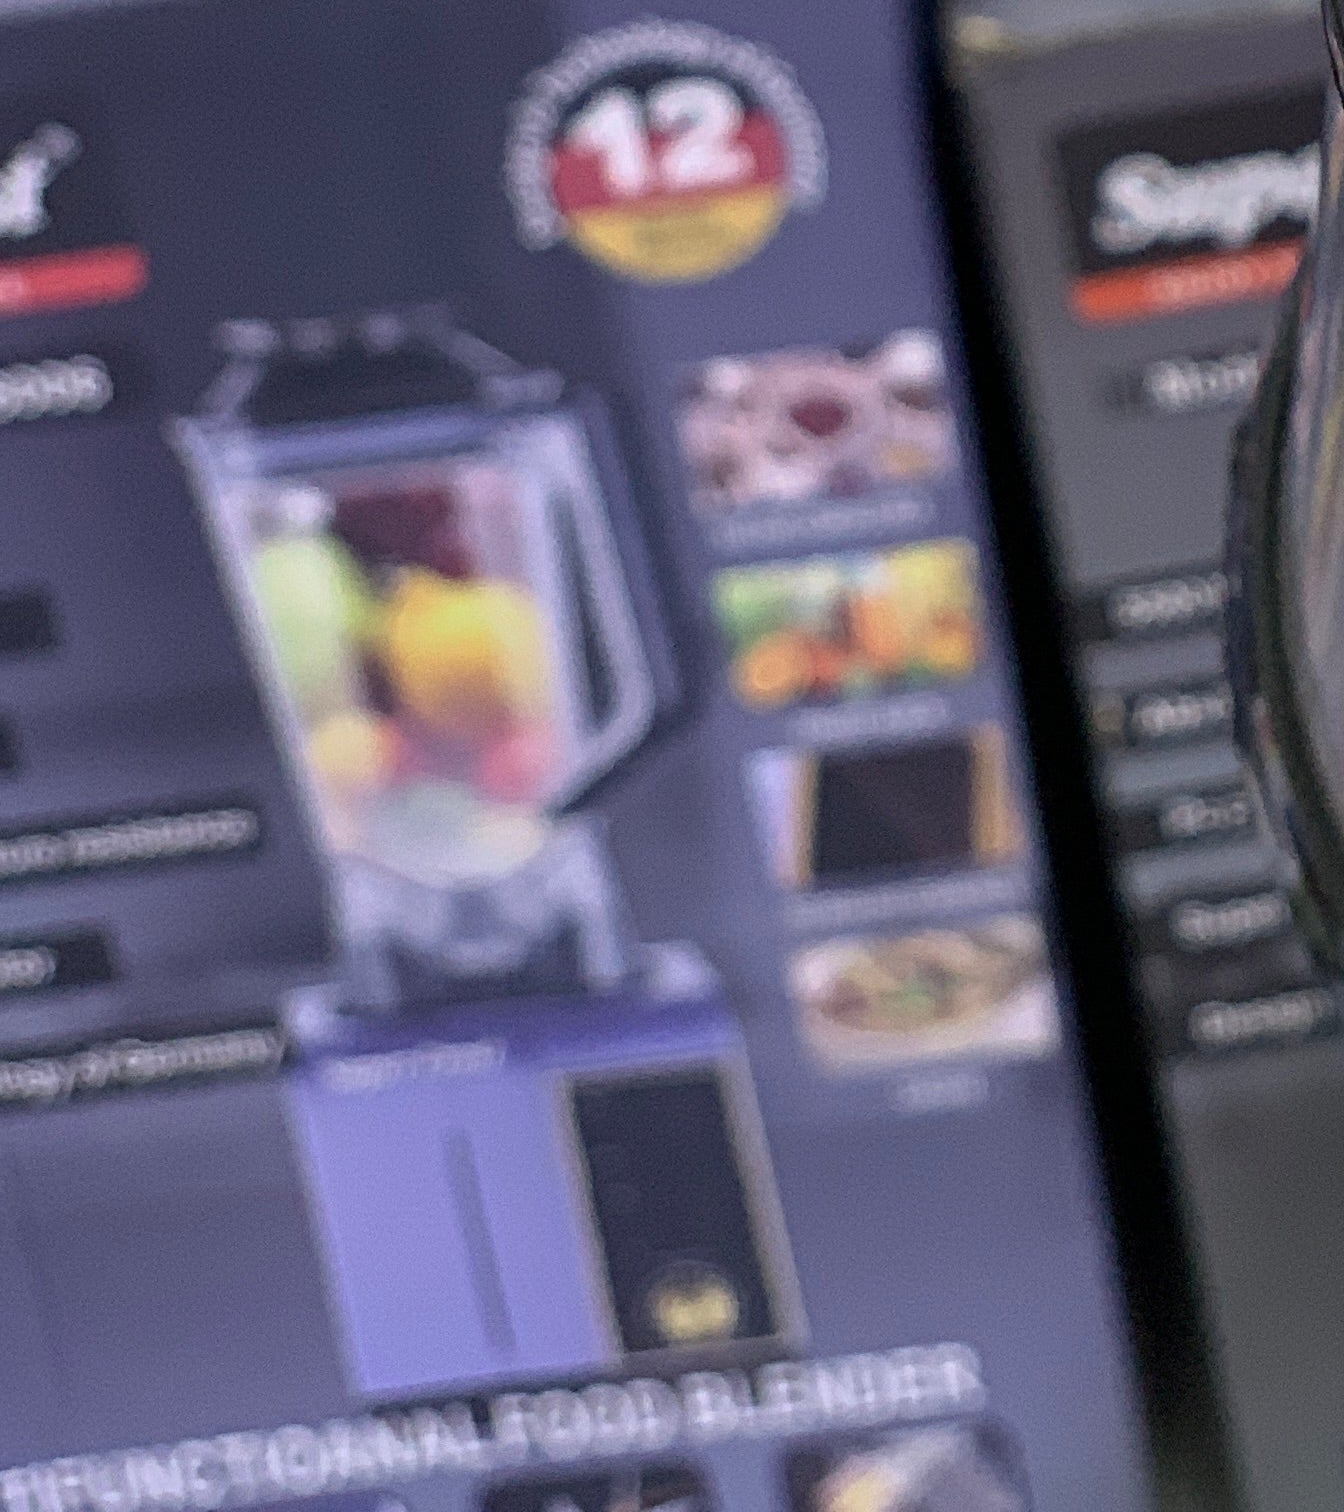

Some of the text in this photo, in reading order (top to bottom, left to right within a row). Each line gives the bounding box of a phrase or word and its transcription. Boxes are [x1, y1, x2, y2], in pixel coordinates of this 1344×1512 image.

[560, 78, 756, 198] 12
[492, 1376, 680, 1466] FOOD
[680, 1341, 986, 1443] BLENDER
